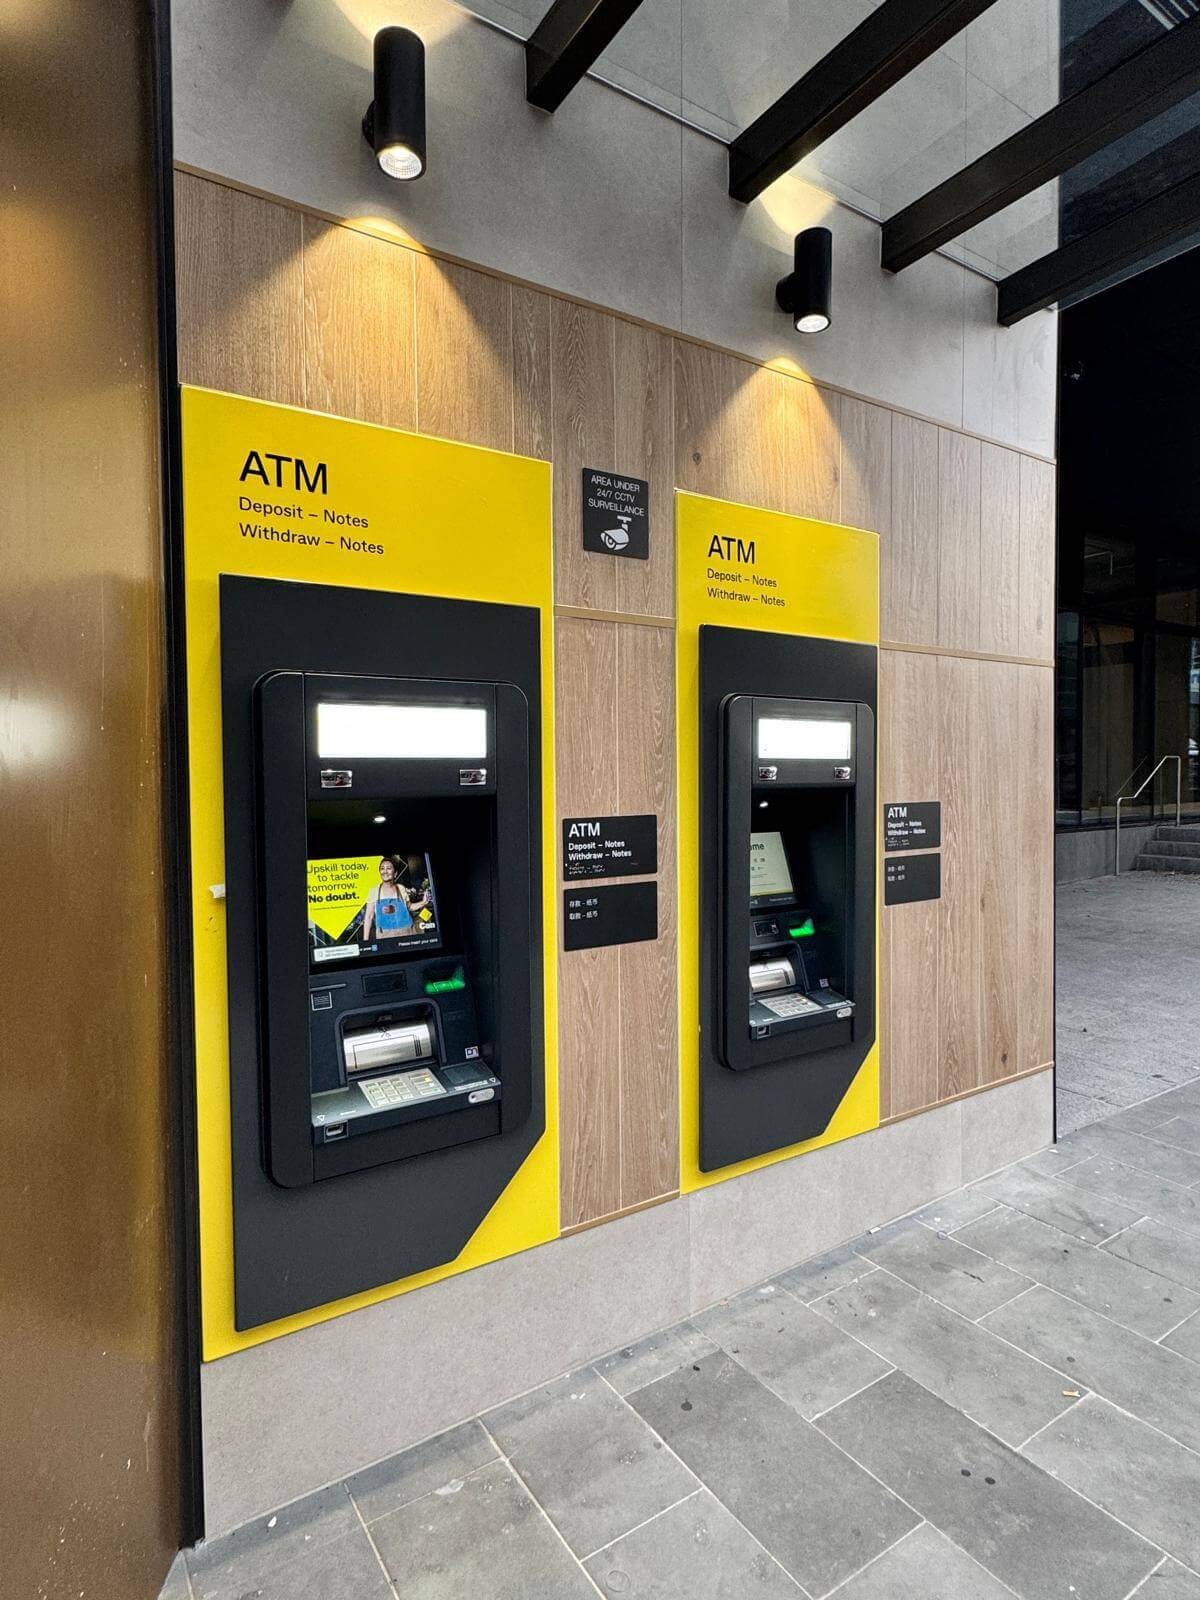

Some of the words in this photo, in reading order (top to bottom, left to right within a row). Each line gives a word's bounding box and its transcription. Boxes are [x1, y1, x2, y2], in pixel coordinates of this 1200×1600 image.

[239, 450, 328, 495] ATM
[591, 474, 612, 487] AREA
[613, 478, 640, 493] UNDER
[596, 488, 613, 498] 24/7
[614, 491, 635, 503] CCTV
[239, 496, 304, 519] Deposit
[323, 510, 369, 528] Notes
[588, 497, 645, 516] SURVEILLANCE
[239, 523, 321, 547] Withdraw
[339, 536, 385, 555] Notes
[707, 534, 756, 564] ATM
[707, 568, 743, 583] Deposit
[752, 574, 778, 587] Notes
[707, 587, 751, 602] Withdraw
[760, 594, 786, 607] Notes
[887, 806, 907, 818] ATM
[568, 822, 600, 838] ATM
[568, 842, 596, 851] Deposit
[605, 840, 625, 848] Notes
[568, 851, 603, 861] Withdraw
[611, 849, 632, 858] Notes
[340, 862, 369, 871] today,
[329, 871, 360, 881] tackle
[308, 894, 323, 903] No
[325, 892, 360, 902] doubt.
[419, 922, 436, 930] Can
